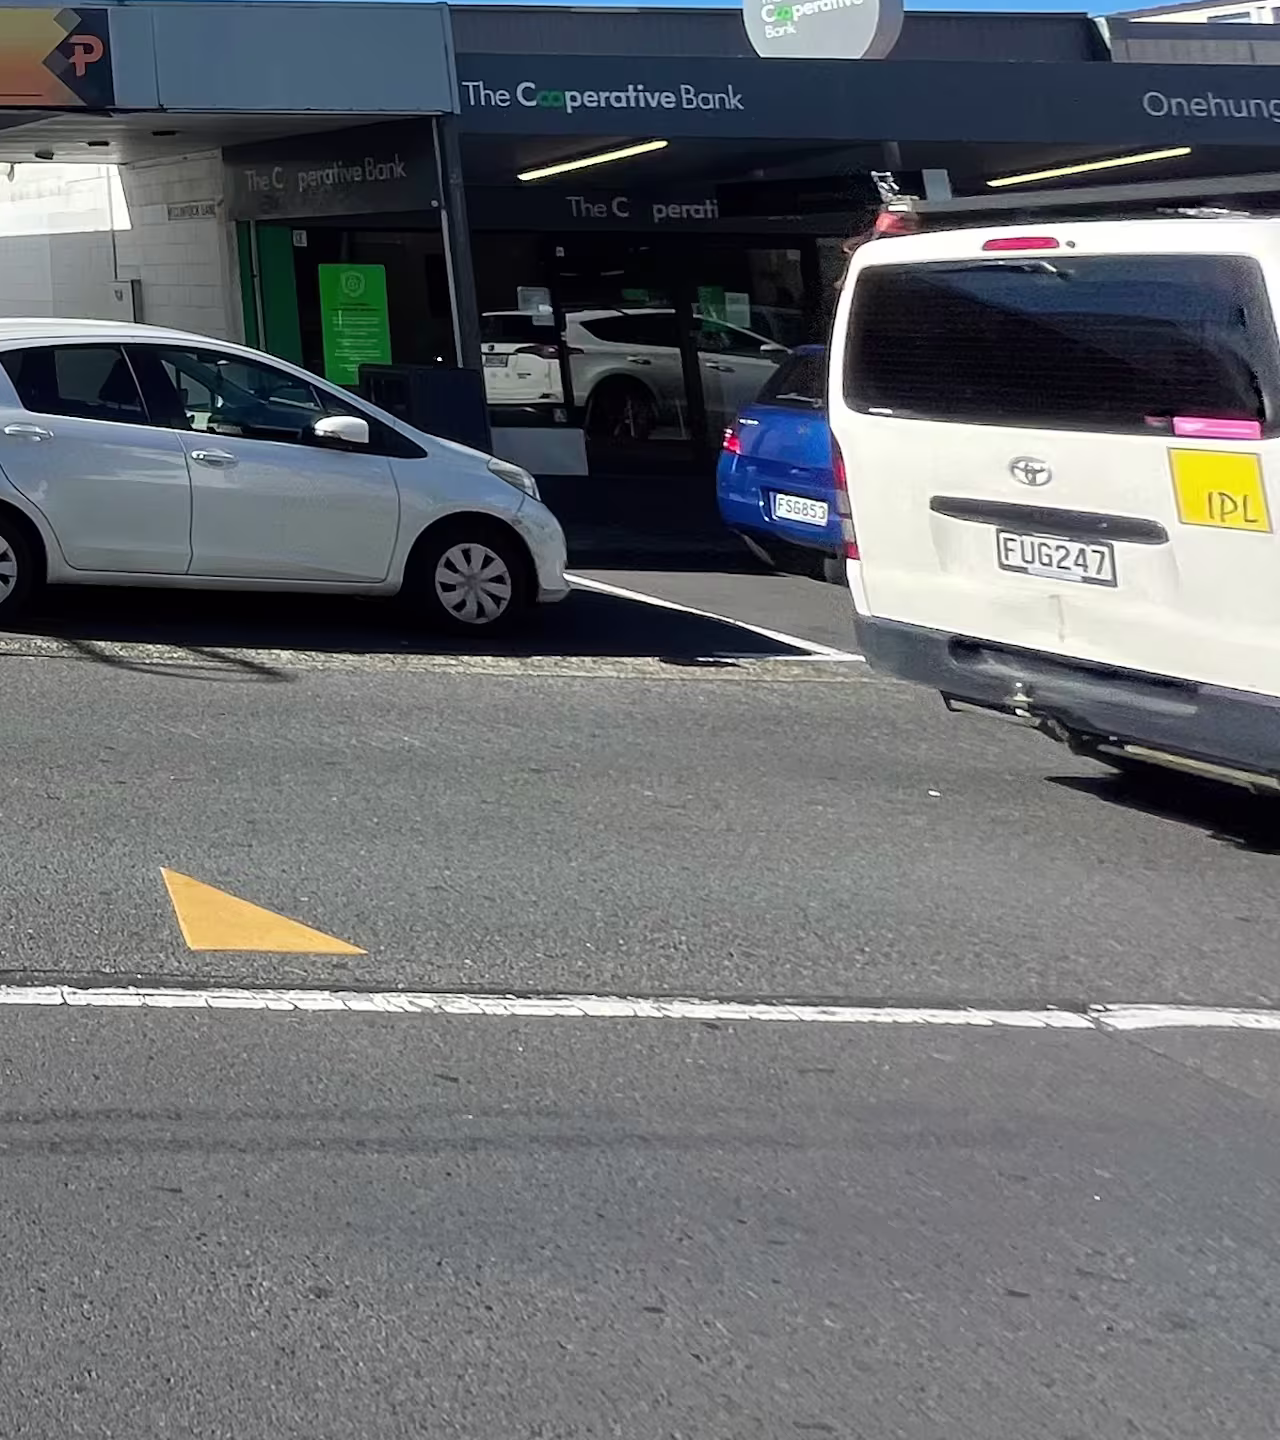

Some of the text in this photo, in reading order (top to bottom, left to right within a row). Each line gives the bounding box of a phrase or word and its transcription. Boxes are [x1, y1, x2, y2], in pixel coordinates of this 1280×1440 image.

[764, 21, 797, 39] Bank
[461, 81, 745, 114] The Cooperative Bank
[244, 169, 271, 192] The
[364, 153, 408, 181] Bank
[565, 196, 608, 219] The
[777, 497, 827, 520] FSG853
[1207, 491, 1259, 523] IPL
[1002, 537, 1107, 576] FUG247
